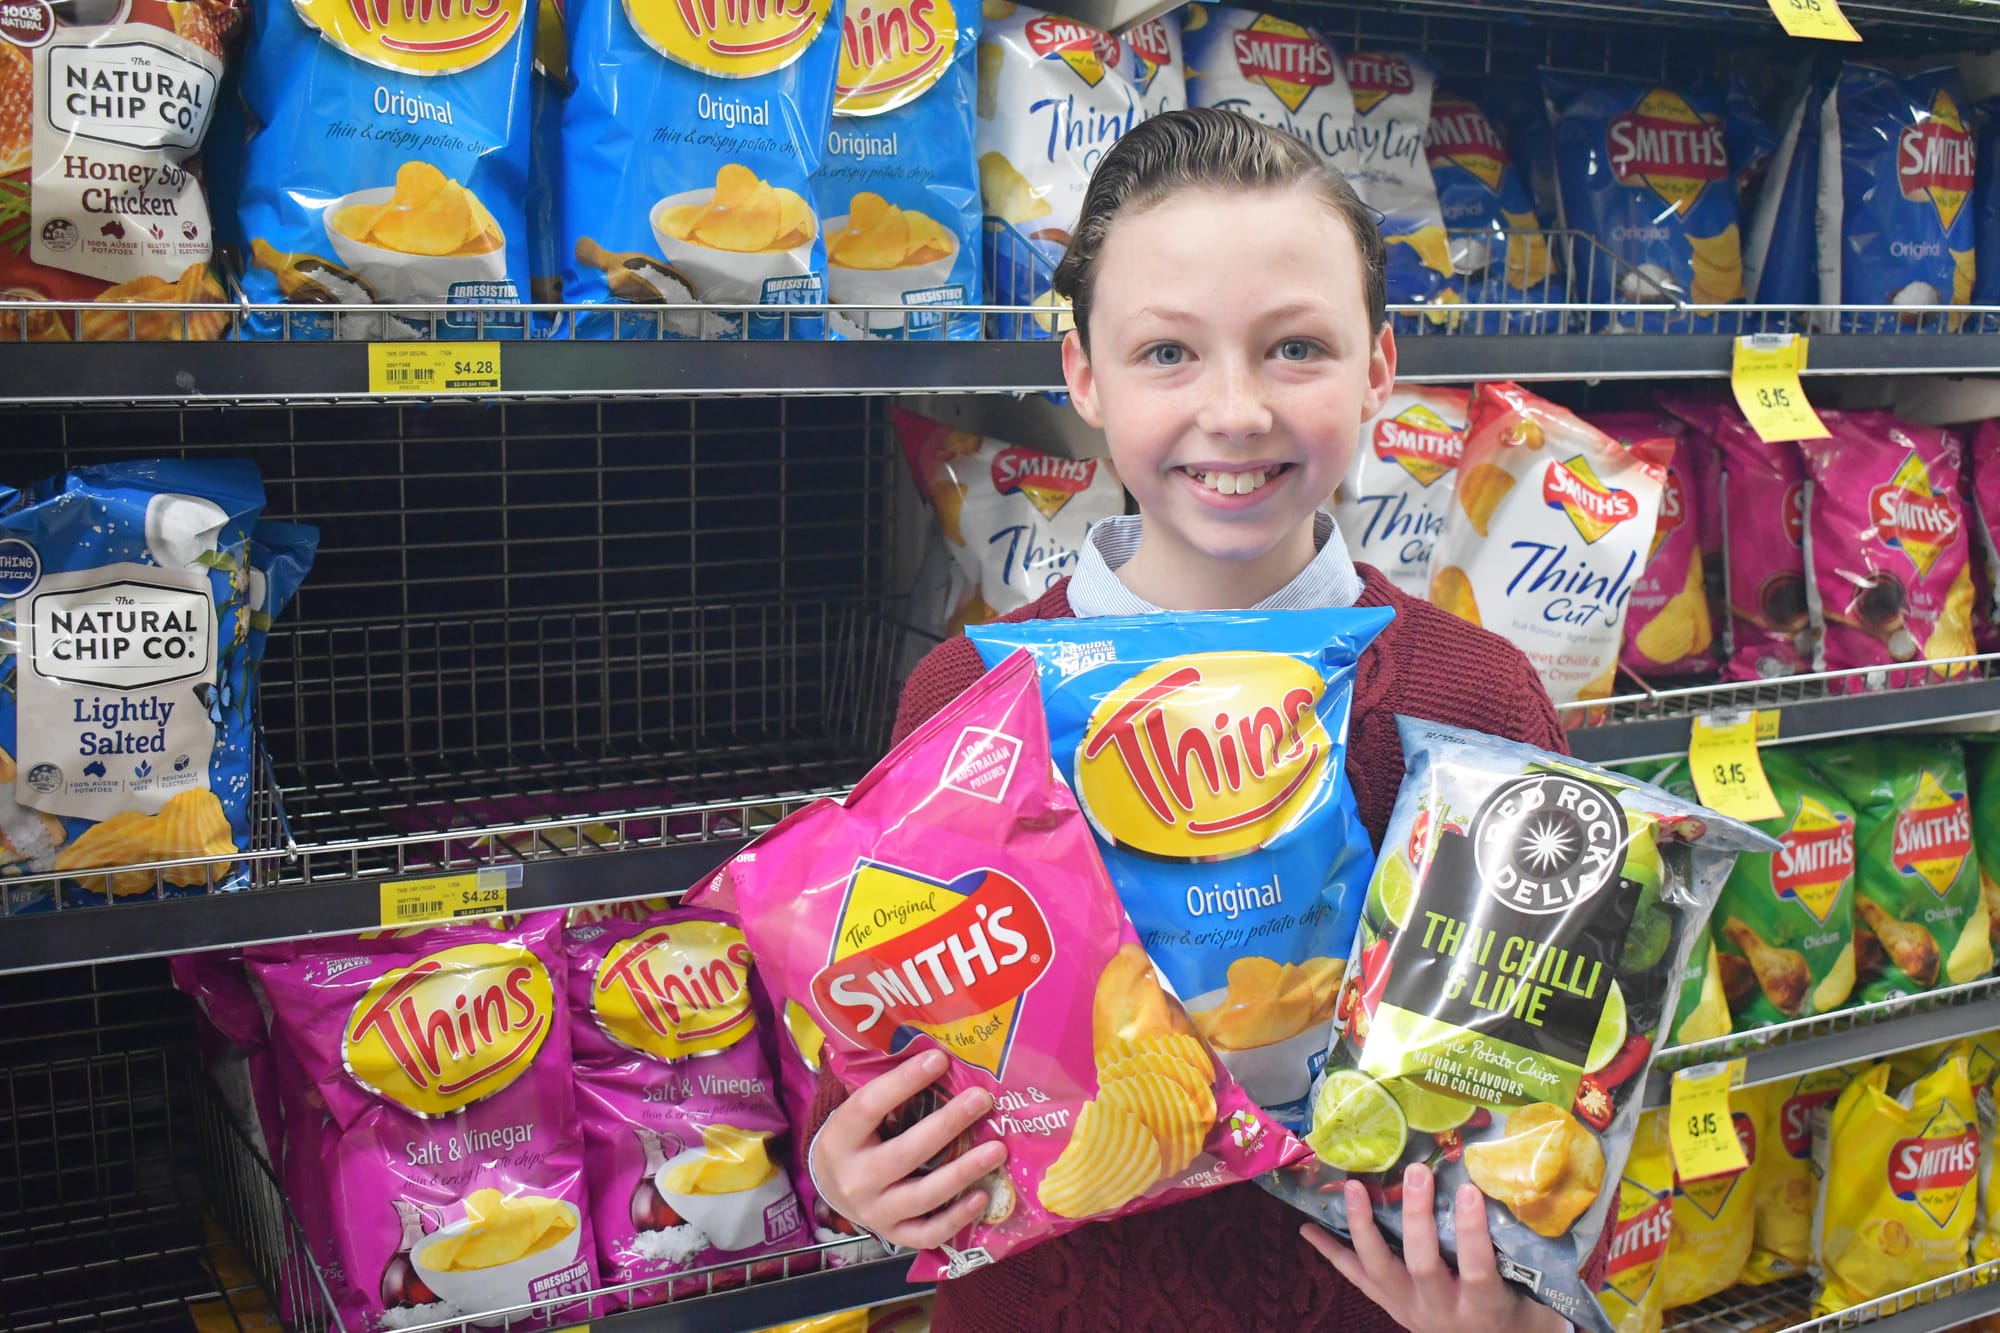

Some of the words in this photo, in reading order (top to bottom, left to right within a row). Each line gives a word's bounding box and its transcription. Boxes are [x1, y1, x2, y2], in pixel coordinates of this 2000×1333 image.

[1, 18, 44, 31] NATURAL
[2, 5, 43, 20] 100%
[131, 56, 150, 66] The
[1235, 34, 1332, 76] SMITH'S
[67, 64, 202, 109] NATURAL
[67, 93, 146, 119] CHIP
[159, 101, 195, 134] CO.
[374, 86, 453, 126] Original
[698, 93, 769, 130] Original
[326, 121, 357, 139] thin
[361, 123, 372, 140] &
[375, 128, 420, 150] crispy
[418, 132, 464, 151] potato
[652, 126, 680, 143] thin
[684, 128, 695, 143] &
[698, 131, 739, 153] crispy
[738, 136, 777, 154] potato
[828, 131, 898, 161] Original
[1610, 121, 1727, 167] SMITH'S
[64, 155, 157, 190] Honey
[158, 162, 187, 192] Soy
[82, 188, 177, 216] Chicken
[91, 248, 133, 256] POTATOES
[111, 241, 138, 249] AUSSIE
[455, 361, 493, 375] $4.28
[1548, 466, 1629, 516] SMITH'S
[1880, 491, 1956, 534] SMITH'S
[0, 556, 33, 568] THING
[1506, 541, 1637, 627] Thinly
[115, 596, 135, 605] The
[1543, 598, 1603, 626] Cut
[52, 610, 198, 634] NATURAL
[52, 637, 130, 660] CHIP
[143, 636, 195, 659] CO.
[1061, 652, 1117, 677] MADE
[73, 697, 175, 729] Lightly
[79, 728, 166, 756] Salted
[1085, 667, 1314, 825] Thins
[956, 746, 1011, 784] AUSTRALIAN
[970, 765, 1006, 790] POTATOES
[1556, 785, 1611, 866] ROCK
[1895, 806, 1970, 854] SMITH'S
[1777, 829, 1853, 878] SMITH'S
[462, 889, 499, 904] $4.28
[1187, 875, 1282, 919] Original
[845, 923, 873, 948] The
[873, 891, 936, 925] Original
[1146, 930, 1175, 947] thin
[1180, 929, 1191, 946] &
[1195, 927, 1244, 950] crispy
[1246, 915, 1294, 946] potato
[829, 903, 1028, 1032] SMITH'S
[1422, 910, 1497, 967] THAI
[1498, 935, 1602, 1000] CHILLI
[1470, 969, 1553, 1027] LIME
[353, 961, 535, 1088] Thins
[955, 1033, 976, 1047] the
[973, 1015, 1003, 1042] Best
[1413, 1050, 1462, 1077] NATURAL
[1465, 1066, 1524, 1096] FLAVOURS
[1471, 1039, 1516, 1069] Potato
[1516, 1057, 1560, 1088] Chips
[642, 1083, 677, 1102] Salt
[681, 1078, 694, 1097] &
[1027, 1086, 1051, 1104] &
[1425, 1069, 1447, 1087] AND
[1451, 1077, 1502, 1104] COLOURS
[988, 1108, 1070, 1137] Vinegar
[406, 1141, 443, 1166] Salt
[448, 1137, 461, 1161] &
[463, 1123, 534, 1154] Vinegar
[1895, 1136, 1976, 1180] SMITH'S
[1182, 1169, 1212, 1188] 170g
[1199, 1174, 1224, 1188] NET
[1544, 1287, 1574, 1306] 165g
[1552, 1301, 1577, 1316] NET
